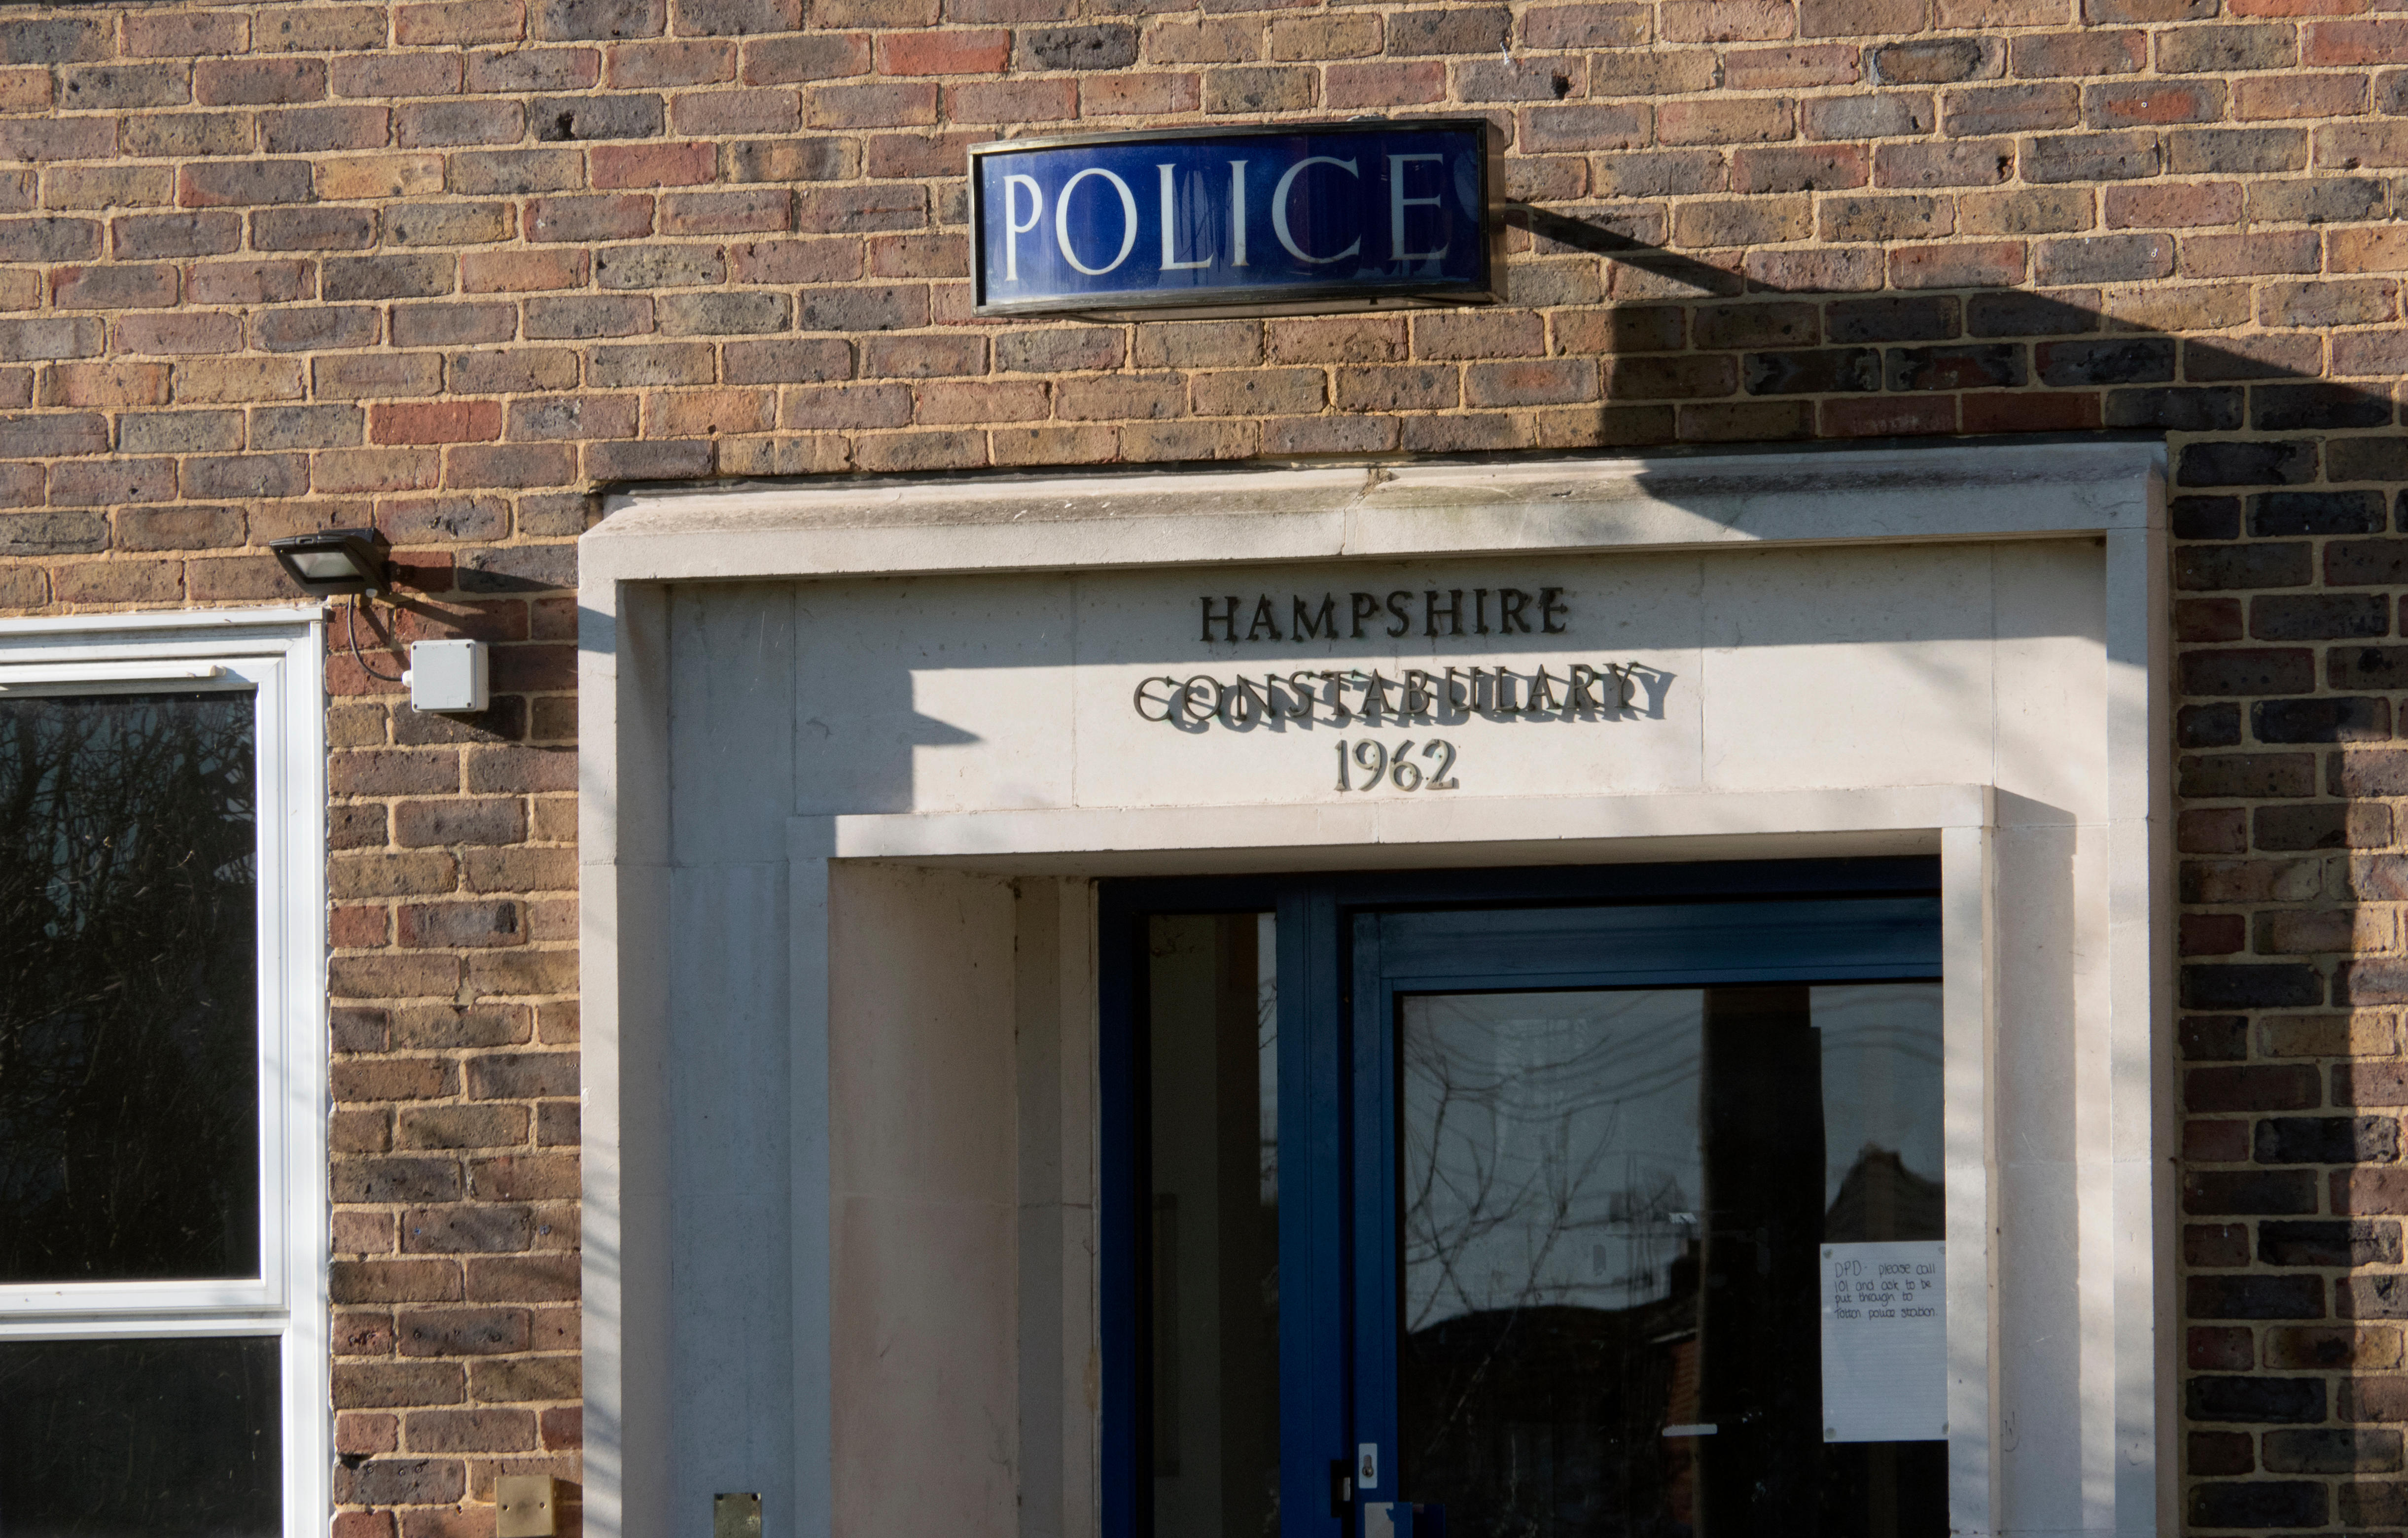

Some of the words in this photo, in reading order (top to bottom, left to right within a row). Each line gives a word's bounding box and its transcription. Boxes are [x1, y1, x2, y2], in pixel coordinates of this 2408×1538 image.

[1003, 153, 1450, 282] POLICE
[1199, 587, 1568, 642] HAMPSHIRE
[1133, 662, 1638, 722] CONSTABULARY
[1334, 738, 1458, 792] 1962
[1834, 1280, 1848, 1293] 101
[1856, 1280, 1874, 1291] and
[1881, 1280, 1899, 1290] ask
[1906, 1279, 1915, 1290] to
[1921, 1279, 1932, 1289] be
[1878, 1263, 1911, 1278] please
[1916, 1263, 1936, 1275] call
[1835, 1293, 1852, 1307] put
[1859, 1292, 1895, 1306] through
[1903, 1292, 1913, 1301] to
[1869, 1307, 1895, 1320] police
